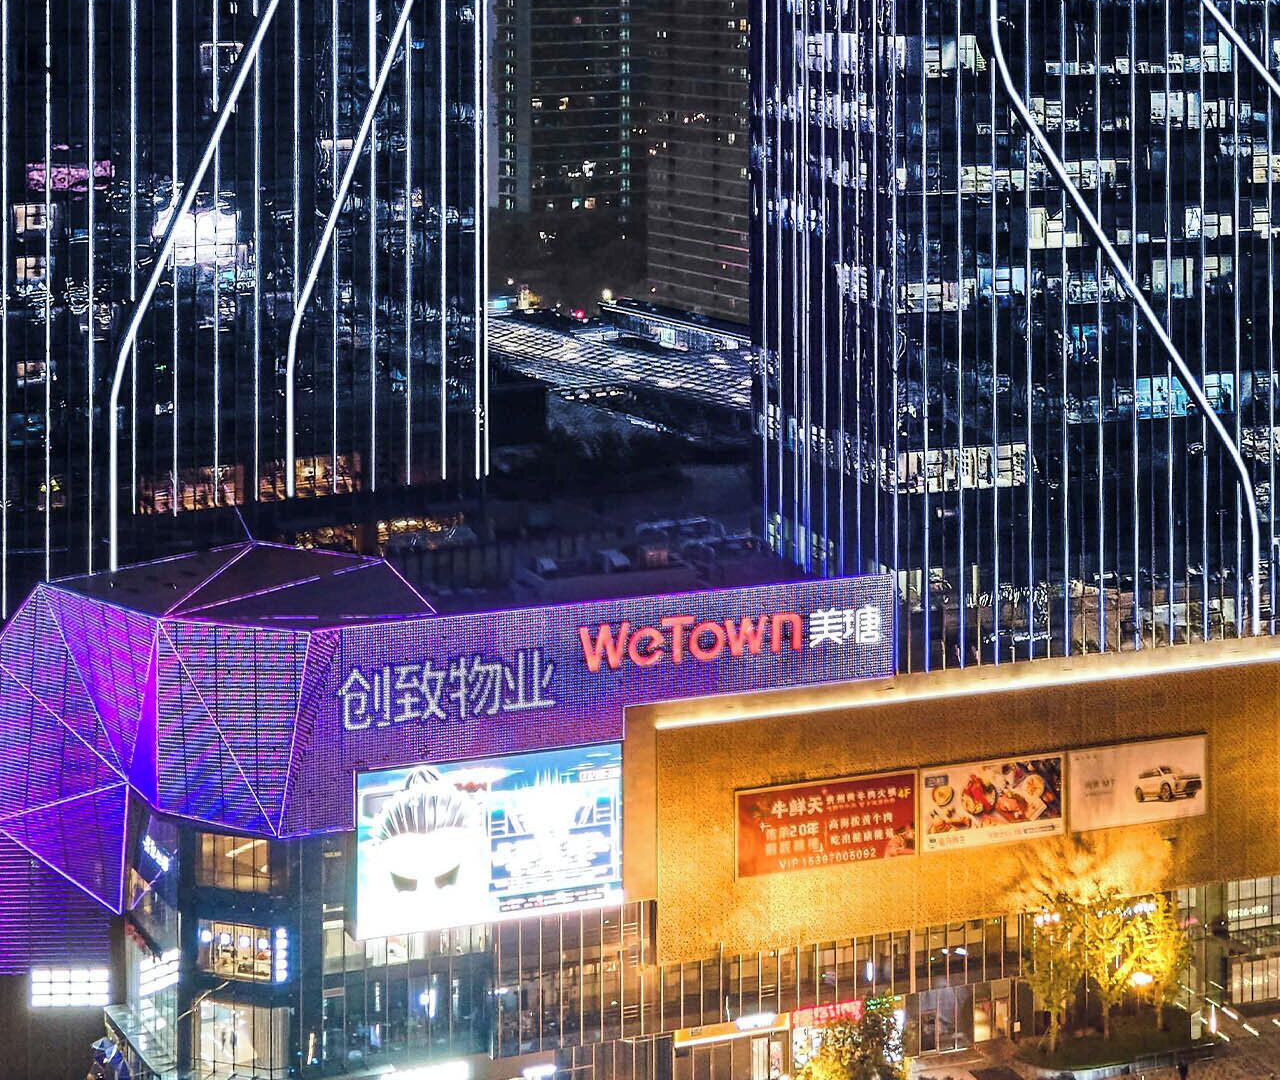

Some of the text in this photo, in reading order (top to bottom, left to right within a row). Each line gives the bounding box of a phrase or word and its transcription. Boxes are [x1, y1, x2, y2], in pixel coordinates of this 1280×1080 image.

[580, 612, 803, 672] WeTown
[337, 651, 556, 730] 创致物业
